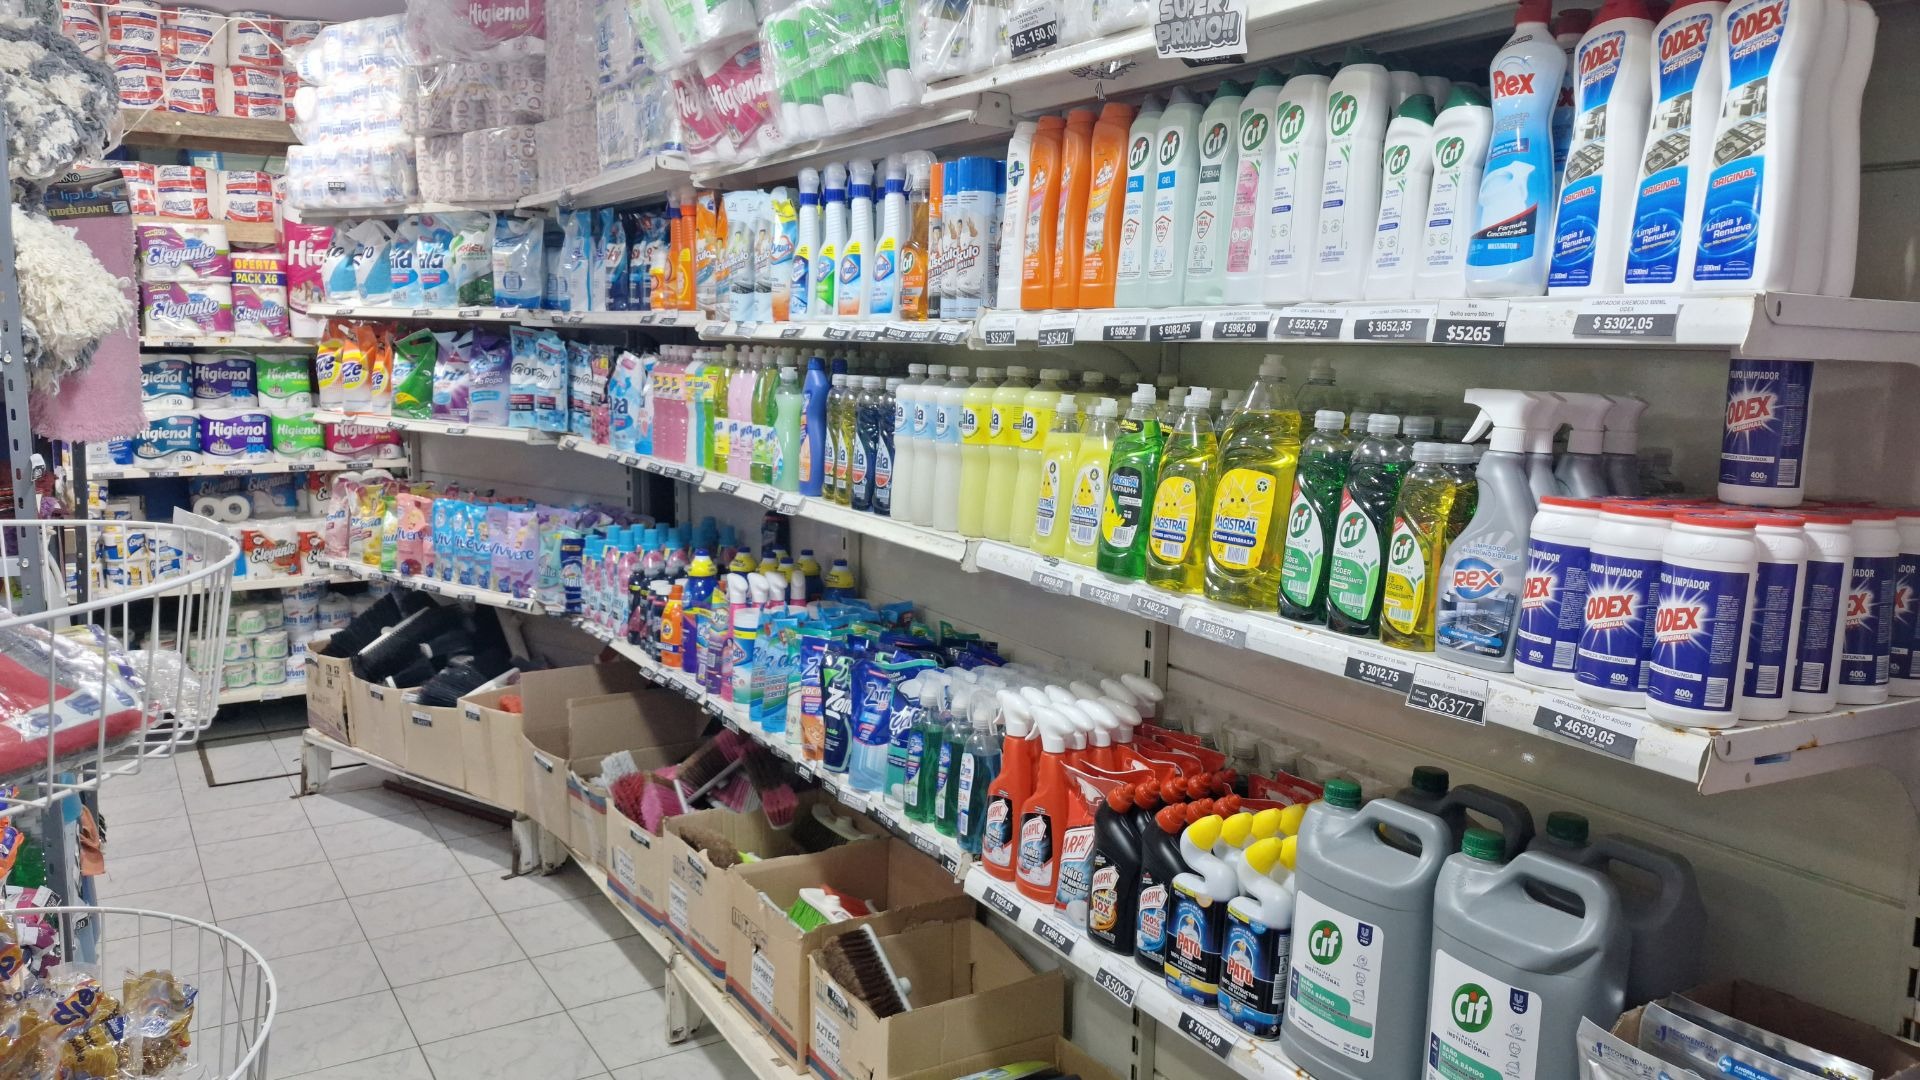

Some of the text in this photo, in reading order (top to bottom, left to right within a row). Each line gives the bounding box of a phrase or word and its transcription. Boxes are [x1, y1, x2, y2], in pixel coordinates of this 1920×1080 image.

[468, 0, 530, 27] Higienol
[1730, 1, 1785, 45] ODEX
[1660, 19, 1707, 60] ODEX
[1733, 34, 1779, 60] CREMOSO
[1580, 36, 1621, 75] ODEX
[1663, 51, 1702, 74] CREMOSO
[1493, 70, 1536, 100] Rex
[1280, 109, 1304, 141] Cif
[1331, 99, 1356, 133] Cif
[1204, 127, 1227, 156] Cif
[1243, 117, 1267, 146] Cif
[1130, 139, 1147, 165] Cif
[1161, 133, 1180, 162] Cif
[1442, 139, 1462, 165] Cif
[1391, 147, 1408, 173] Cif
[1161, 176, 1171, 184] GEL
[1201, 170, 1220, 178] CREMA
[1712, 168, 1757, 189] ORIGINAL
[1642, 178, 1680, 197] ORIGINAL
[1486, 227, 1527, 238] Concentrada
[1636, 224, 1661, 238] Limpia
[1706, 216, 1743, 232] Limpia y
[1713, 223, 1752, 239] Renueva
[1562, 236, 1592, 250] Renueva
[1642, 229, 1677, 244] Renueva
[146, 244, 217, 268] Elegante
[233, 258, 279, 270] OFERTA
[235, 272, 279, 284] PACK X6
[1702, 264, 1722, 272] 500ml
[150, 298, 220, 321] Elegante
[235, 306, 285, 322] Elegante
[1222, 322, 1257, 334] $ 5982,60
[1287, 319, 1329, 330] $ 5235,75
[1368, 320, 1413, 333] $ 3652,35
[1446, 324, 1491, 341] $5265
[1592, 316, 1601, 330] $
[990, 330, 1011, 343] $5297
[195, 366, 251, 384] Higienol
[1743, 370, 1779, 381] LIMPIADOR
[1727, 395, 1771, 426] ODEX
[209, 421, 267, 441] Higienol
[277, 424, 321, 437] Higienol
[1750, 471, 1768, 480] 400g
[1153, 514, 1188, 532] MAGISTRAL
[1215, 513, 1257, 535] MAGISTRAL
[1291, 508, 1310, 533] Cif
[1341, 518, 1364, 544] Cif
[251, 543, 297, 564] Elegante
[1391, 539, 1413, 562] Cif
[1605, 566, 1643, 579] LIMPIADOR
[1672, 576, 1710, 591] LIMPIADOR
[1586, 593, 1634, 621] ODEX
[1655, 605, 1701, 633] ODEX
[1358, 662, 1400, 682] $ 3012,75
[1610, 671, 1629, 683] 400g
[1674, 687, 1694, 701] 400g
[1428, 693, 1475, 718] $6377
[1551, 697, 1581, 710] LIMPIADOR
[1591, 708, 1611, 719] POLVO
[1580, 714, 1597, 723] ODEX
[1553, 714, 1616, 746] $ 4639,05
[1093, 872, 1113, 887] HARPIC
[1094, 900, 1110, 914] 10X
[1141, 891, 1161, 905] HARPIC
[1143, 912, 1160, 926] 100%
[1176, 932, 1202, 960] PATO
[1311, 927, 1340, 958] Cif
[1227, 956, 1254, 988] PATO
[1304, 963, 1341, 987] INSTITUCIONAL
[1102, 973, 1130, 1001] $5006
[1454, 991, 1489, 1025] Cif
[1187, 1018, 1221, 1047] $ 7605,00
[1446, 1030, 1491, 1058] INSTITUCIONAL
[1460, 1062, 1485, 1079] RÁPIDO
